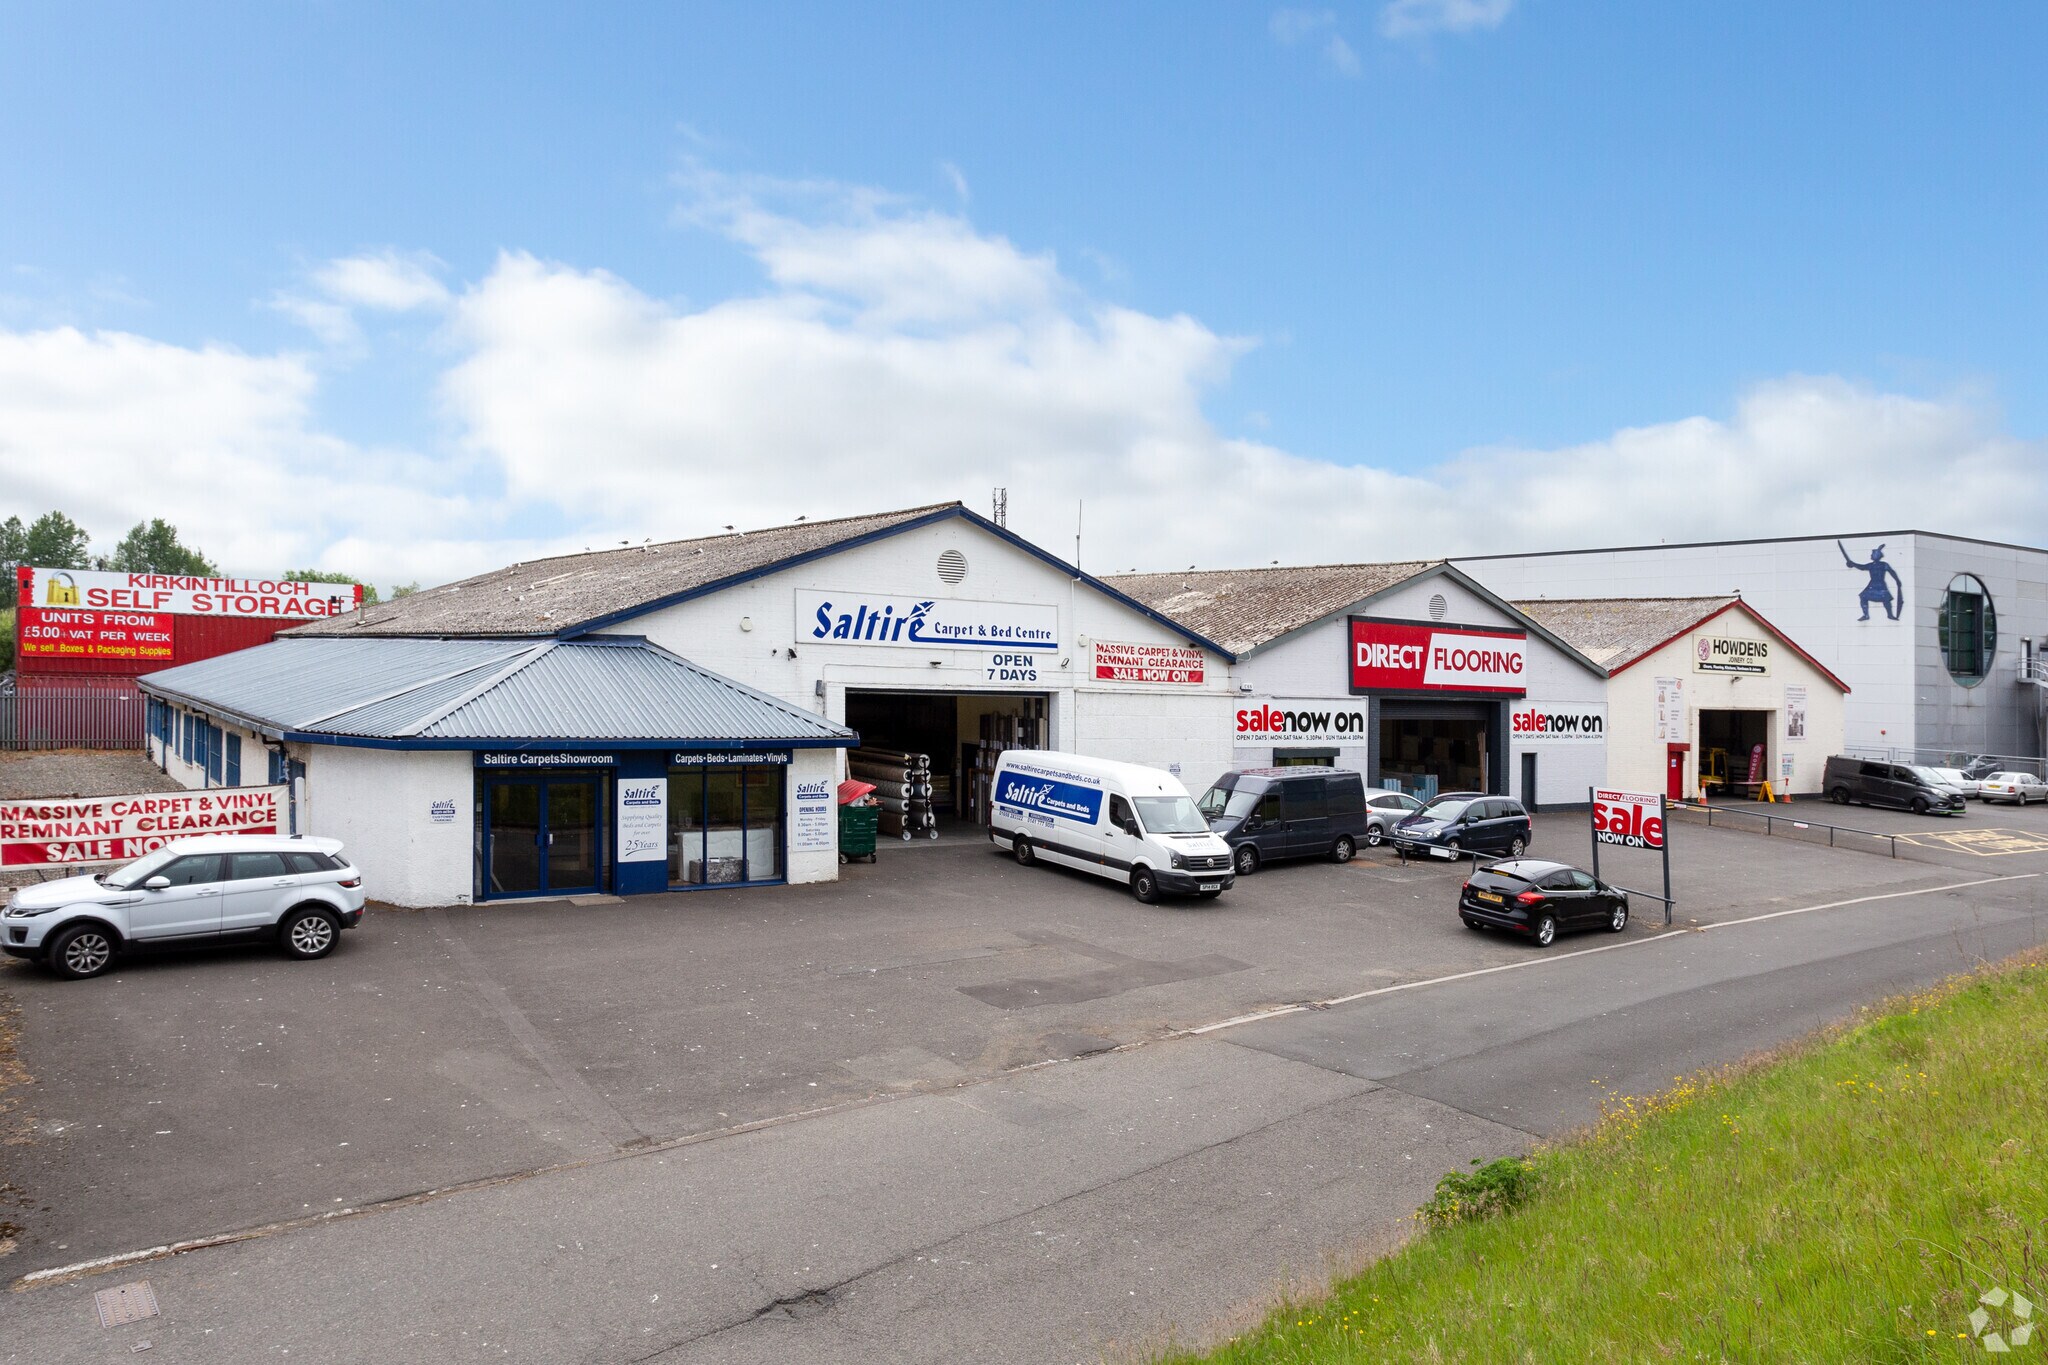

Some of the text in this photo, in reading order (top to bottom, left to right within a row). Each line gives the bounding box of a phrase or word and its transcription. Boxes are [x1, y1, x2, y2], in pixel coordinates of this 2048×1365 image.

[129, 573, 310, 596] KIRKINTILLOCH
[87, 587, 344, 616] SELF STORAGE
[41, 612, 154, 626] UNITS FROM
[813, 601, 926, 642] Saltire
[70, 630, 93, 639] VAT
[100, 631, 126, 640] PER
[133, 632, 171, 642] WEEK
[935, 622, 1051, 639] Carpet & Bed Centre
[23, 643, 171, 657] We sell Boxes & Packaging Supplies
[1096, 643, 1204, 659] MASSIVE CARPET & VINYL
[1713, 638, 1768, 658] HOWDENS
[993, 654, 1033, 667] OPEN
[1096, 655, 1204, 669] REMNANT CLEARANCE
[1357, 642, 1523, 674] DIRECT FLOORING
[1728, 656, 1745, 664] JOINERY
[987, 669, 1037, 682] 7 DAYS
[1113, 668, 1189, 682] SALE NOW ON
[1236, 704, 1364, 732] sale now on
[1513, 708, 1602, 732] sale now on
[484, 753, 517, 764] Saltire
[1006, 762, 1100, 785] www.saltirecarpetsandbeds.co.uk
[624, 788, 656, 799] Saltire
[797, 783, 825, 793] Saltire
[1005, 782, 1046, 808] Saltire
[431, 800, 455, 809] Saltire
[1046, 797, 1090, 813] Carpets and Beds
[1598, 792, 1657, 804] DIRECT FLOORING
[1, 793, 276, 822] MASSIVE CARPET & VINYL
[1, 808, 277, 839] REMNANT CLEARANCE
[1593, 802, 1663, 847] sale
[625, 840, 658, 851] 25 Years
[1598, 832, 1644, 847] NOW ON
[47, 840, 112, 862] SALE
